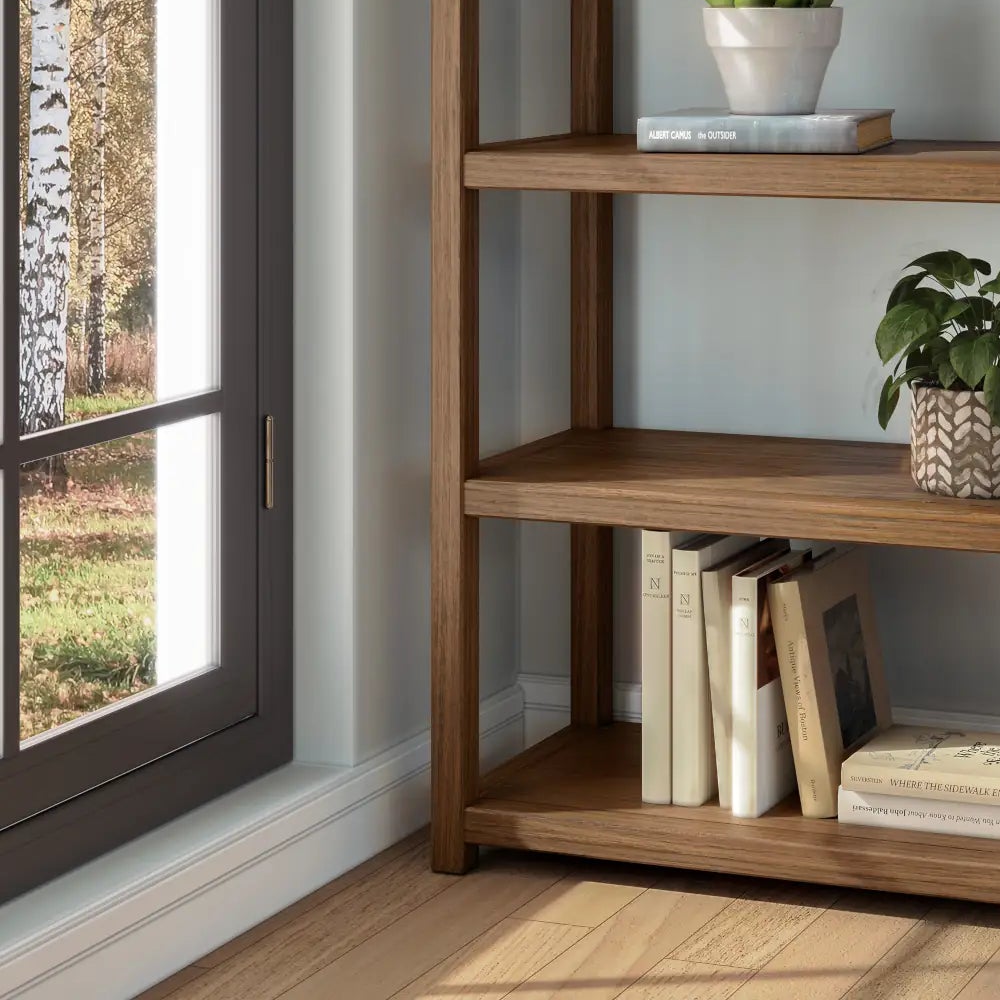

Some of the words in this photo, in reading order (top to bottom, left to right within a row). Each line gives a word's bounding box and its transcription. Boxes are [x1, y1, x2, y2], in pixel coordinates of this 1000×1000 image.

[648, 130, 669, 140] ALBERT
[671, 130, 692, 140] CAMUS
[698, 131, 707, 140] the
[707, 131, 737, 140] OUTSIDER
[890, 778, 923, 790] WHERE
[924, 781, 943, 792] THE
[944, 783, 991, 796] SIDEWALK
[852, 804, 888, 815] Baldessari
[889, 808, 906, 817] John
[907, 811, 926, 819] About
[928, 813, 947, 821] Know
[956, 814, 981, 825] Wanted
[982, 817, 994, 826] You
